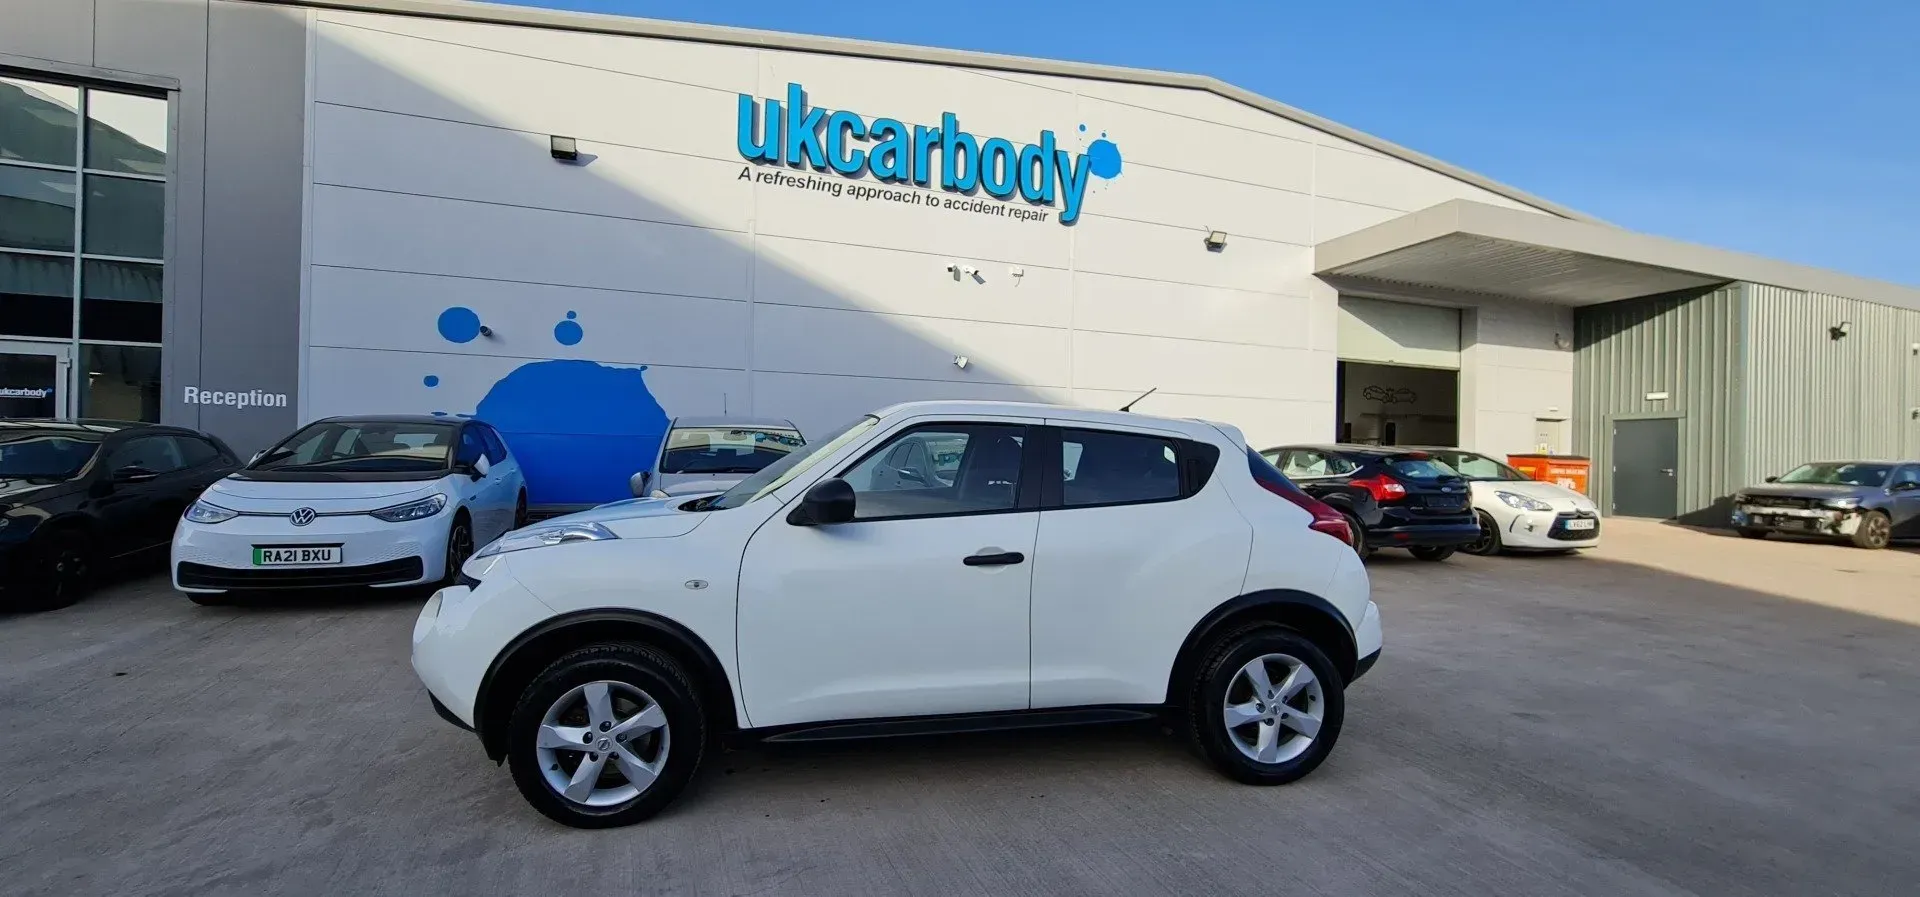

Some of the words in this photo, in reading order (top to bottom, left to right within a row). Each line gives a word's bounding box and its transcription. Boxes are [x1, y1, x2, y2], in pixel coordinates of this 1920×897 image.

[737, 82, 1091, 226] ukcarbody
[738, 166, 751, 181] A
[756, 171, 842, 197] refreshing
[847, 184, 921, 204] approach
[925, 193, 940, 207] to
[944, 198, 1005, 216] accident
[1008, 207, 1049, 222] repair
[0, 387, 47, 398] ukcarbody
[184, 386, 287, 409] Reception
[263, 550, 298, 562] RA21
[301, 549, 331, 562] BXU
